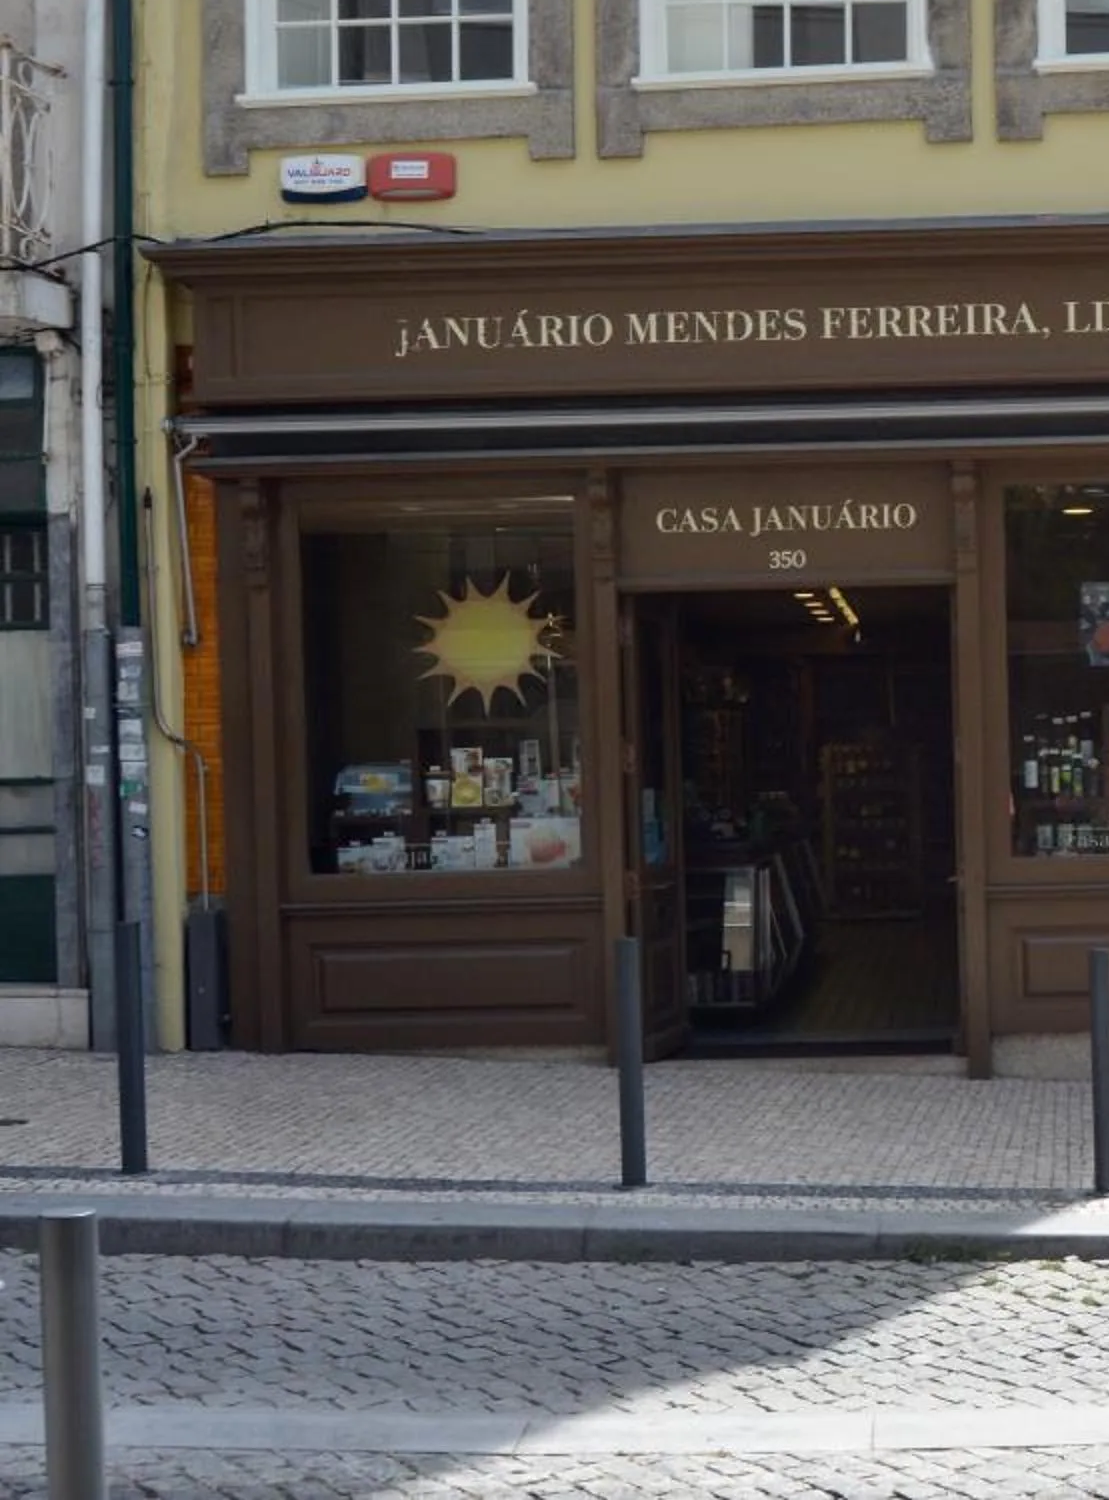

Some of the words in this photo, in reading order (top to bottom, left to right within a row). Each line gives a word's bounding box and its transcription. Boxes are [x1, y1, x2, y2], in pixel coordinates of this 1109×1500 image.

[395, 308, 614, 357] JANUÁRIO
[624, 308, 808, 345] MENDES
[819, 301, 1050, 339] FERREIRA,
[655, 507, 743, 533] CASA
[750, 499, 917, 537] JANUÁRIO
[768, 549, 807, 570] 350
